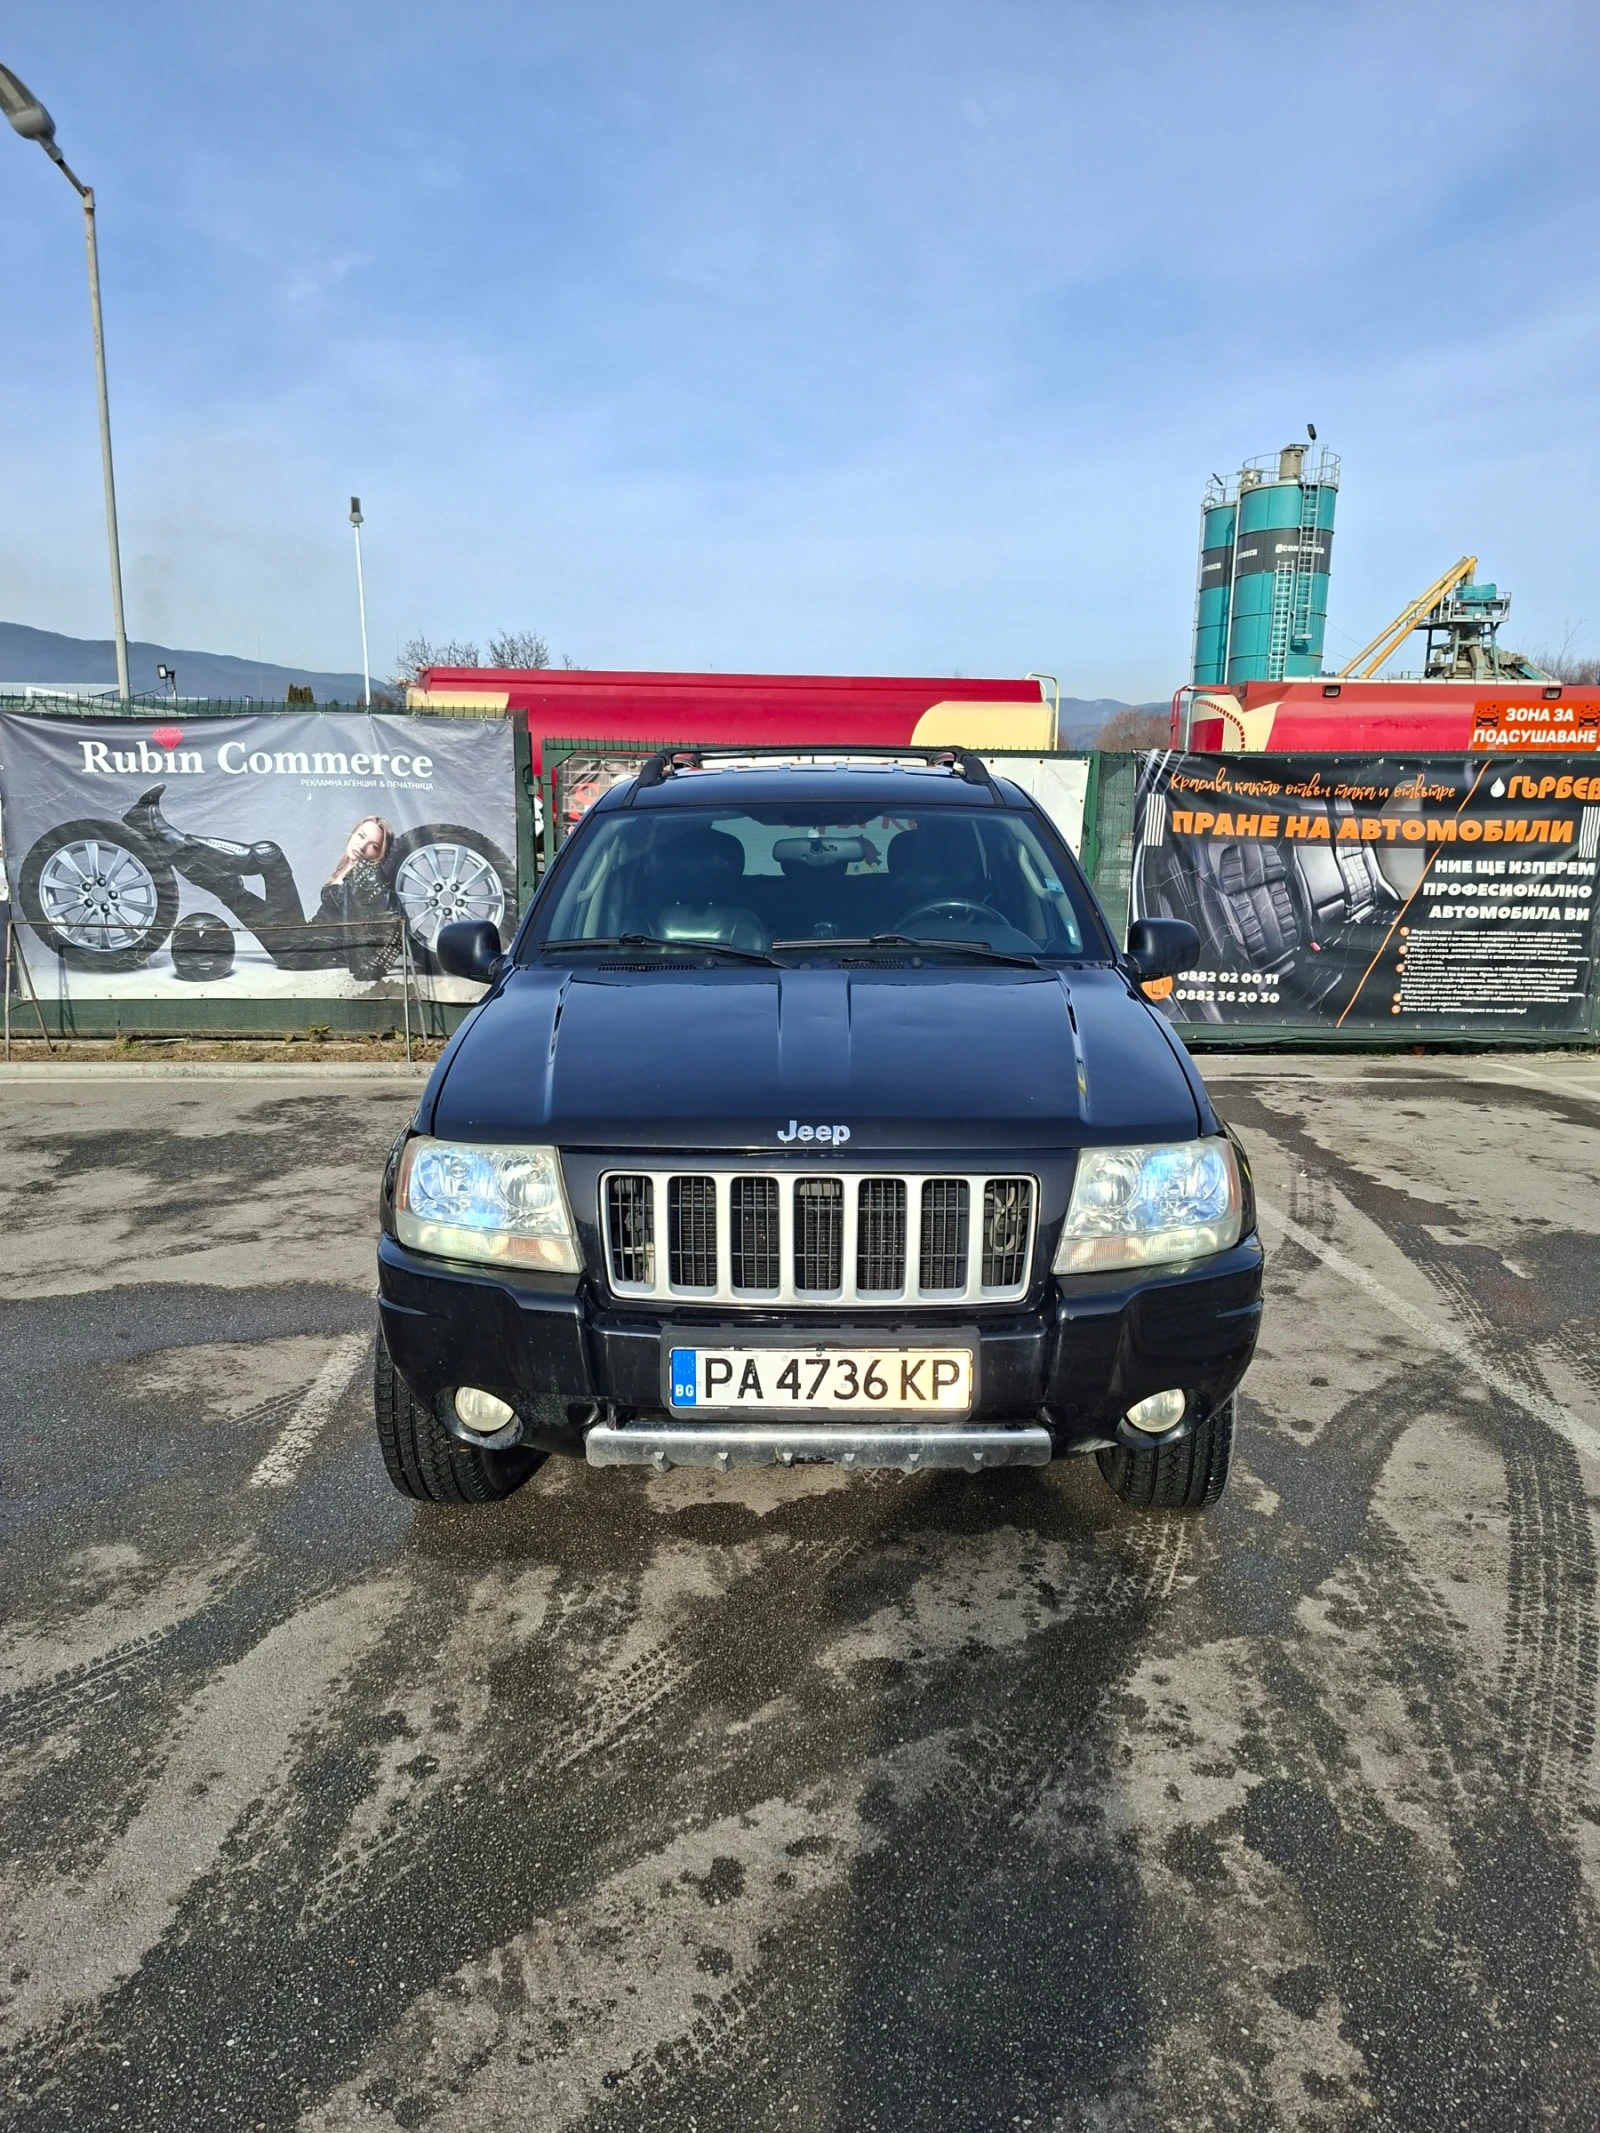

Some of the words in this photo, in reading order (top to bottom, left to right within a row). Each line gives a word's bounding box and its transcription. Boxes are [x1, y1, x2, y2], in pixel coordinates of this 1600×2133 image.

[1505, 708, 1550, 722] ЗОНА
[1553, 709, 1574, 722] ЗА
[1473, 729, 1597, 745] ПОДСУШАВАНЕ
[78, 741, 205, 774] Rubin
[217, 741, 433, 778] Commerce
[301, 779, 342, 787] РЕКЛАМНА
[343, 780, 377, 788] АГЕНЦИЯ
[387, 781, 433, 791] ПЕЧАТНИЦА
[1378, 786, 1389, 799] и
[1172, 811, 1280, 837] ПРАНЕ
[1284, 815, 1331, 838] НА
[1336, 817, 1574, 843] АВТОМОБИЛИ
[1435, 860, 1472, 873] НИЕ
[1476, 861, 1506, 875] ЩЕ
[1508, 861, 1596, 875] ИЗПЕРЕМ
[1422, 883, 1592, 898] ПРОФЕСИОНАЛНО
[1428, 905, 1561, 919] АВТОМОБИЛА
[1563, 908, 1590, 921] ВИ
[1178, 971, 1216, 982] 0882
[1219, 973, 1238, 983] 02
[1241, 973, 1262, 984] 00
[1265, 974, 1279, 985] 11
[1176, 990, 1215, 1001] 0882
[1218, 991, 1235, 1002] 36
[1238, 992, 1257, 1003] 20
[1260, 993, 1280, 1003] 30
[777, 1120, 851, 1146] Jeep
[705, 1358, 764, 1399] PA
[776, 1359, 888, 1400] 4736
[900, 1359, 960, 1401] KP
[675, 1385, 694, 1397] BG
